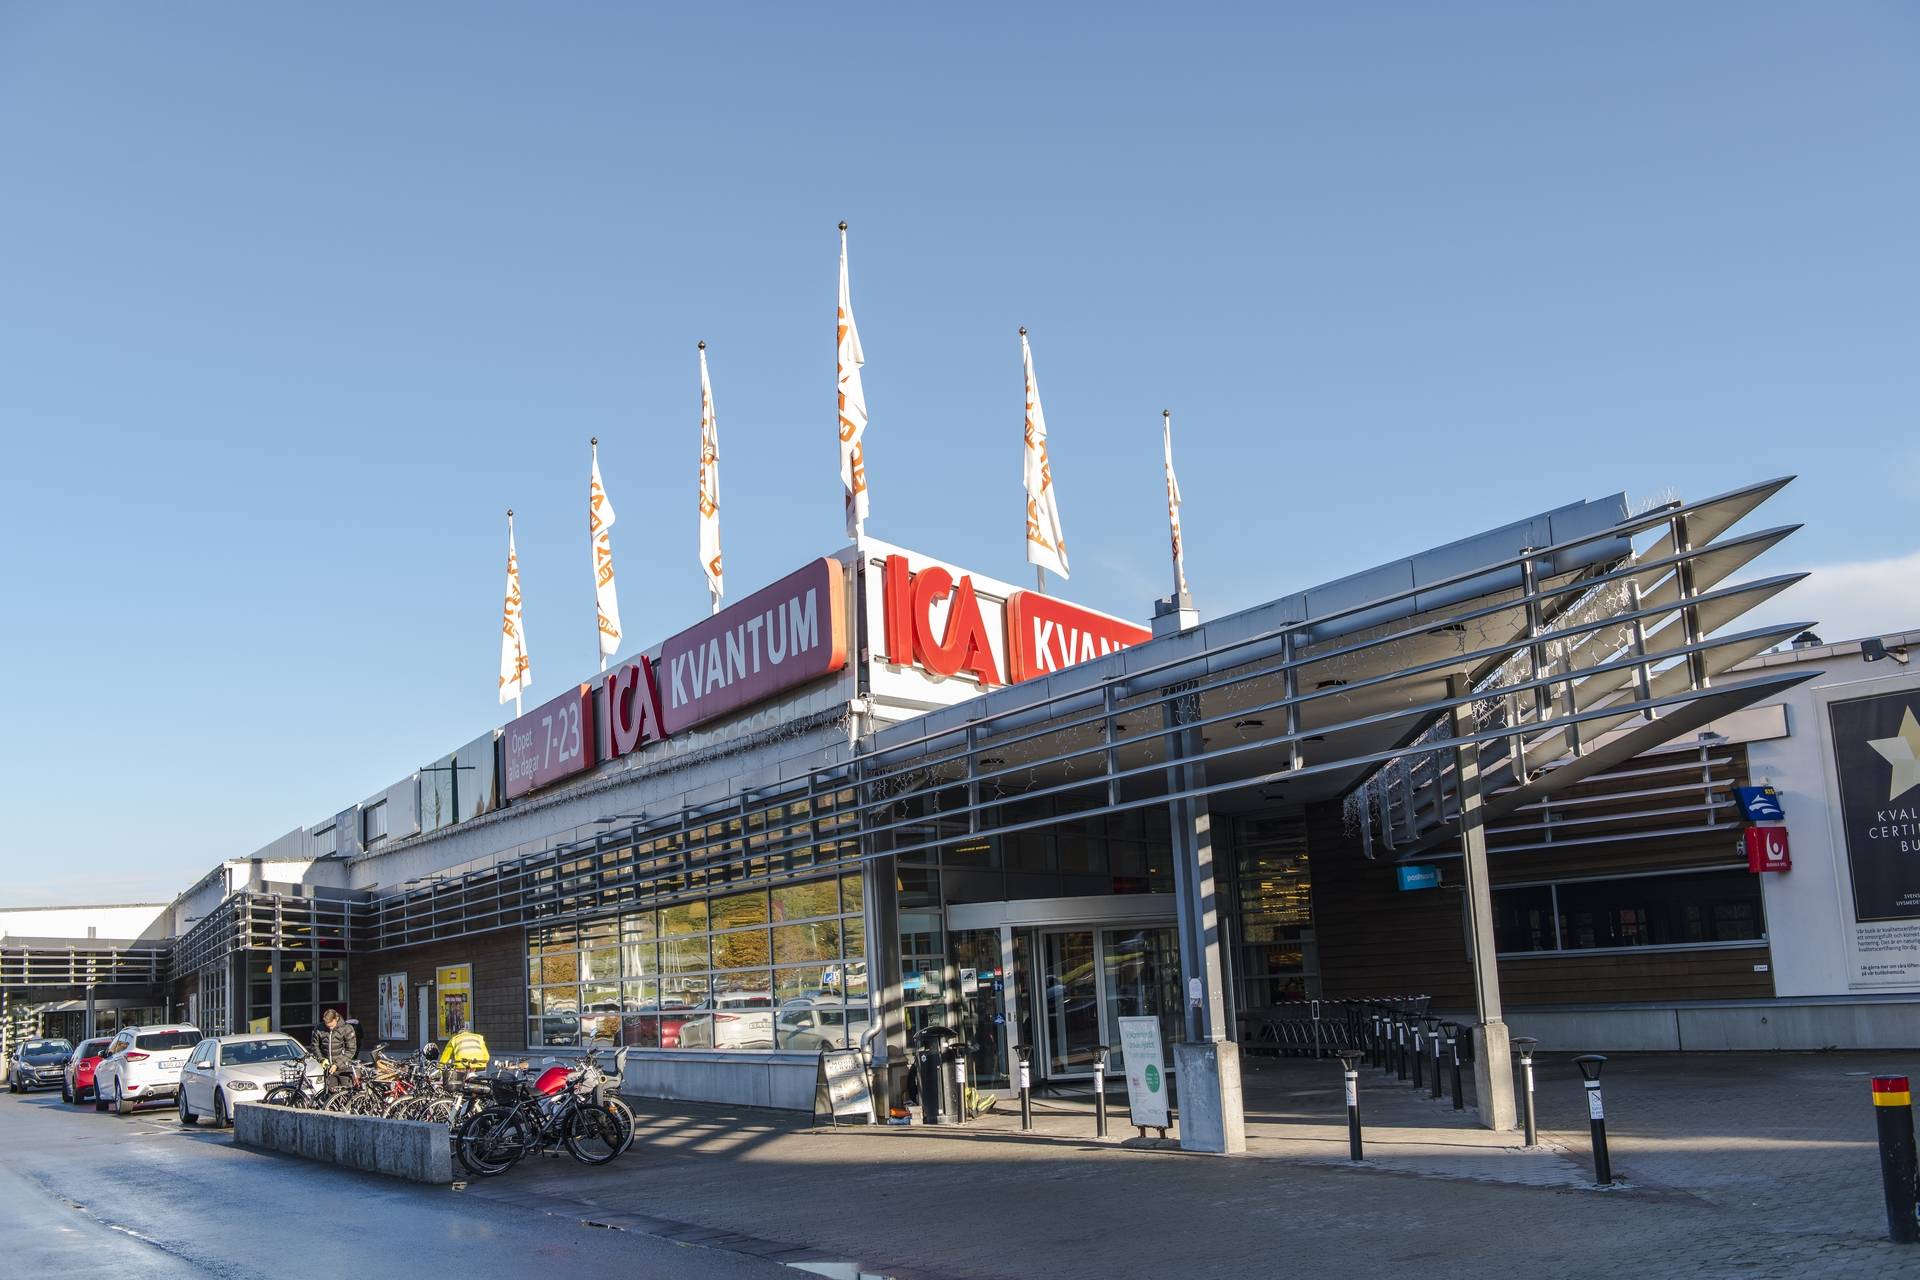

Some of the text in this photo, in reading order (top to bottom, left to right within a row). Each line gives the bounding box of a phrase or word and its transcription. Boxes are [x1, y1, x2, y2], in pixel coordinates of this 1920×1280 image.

[884, 554, 1001, 686] ICA
[602, 587, 819, 760] ICA KVANTUM
[511, 728, 533, 753] Öppet
[541, 702, 580, 769] 7-23
[508, 754, 540, 782] alla dagar
[1869, 823, 1920, 839] CERTI
